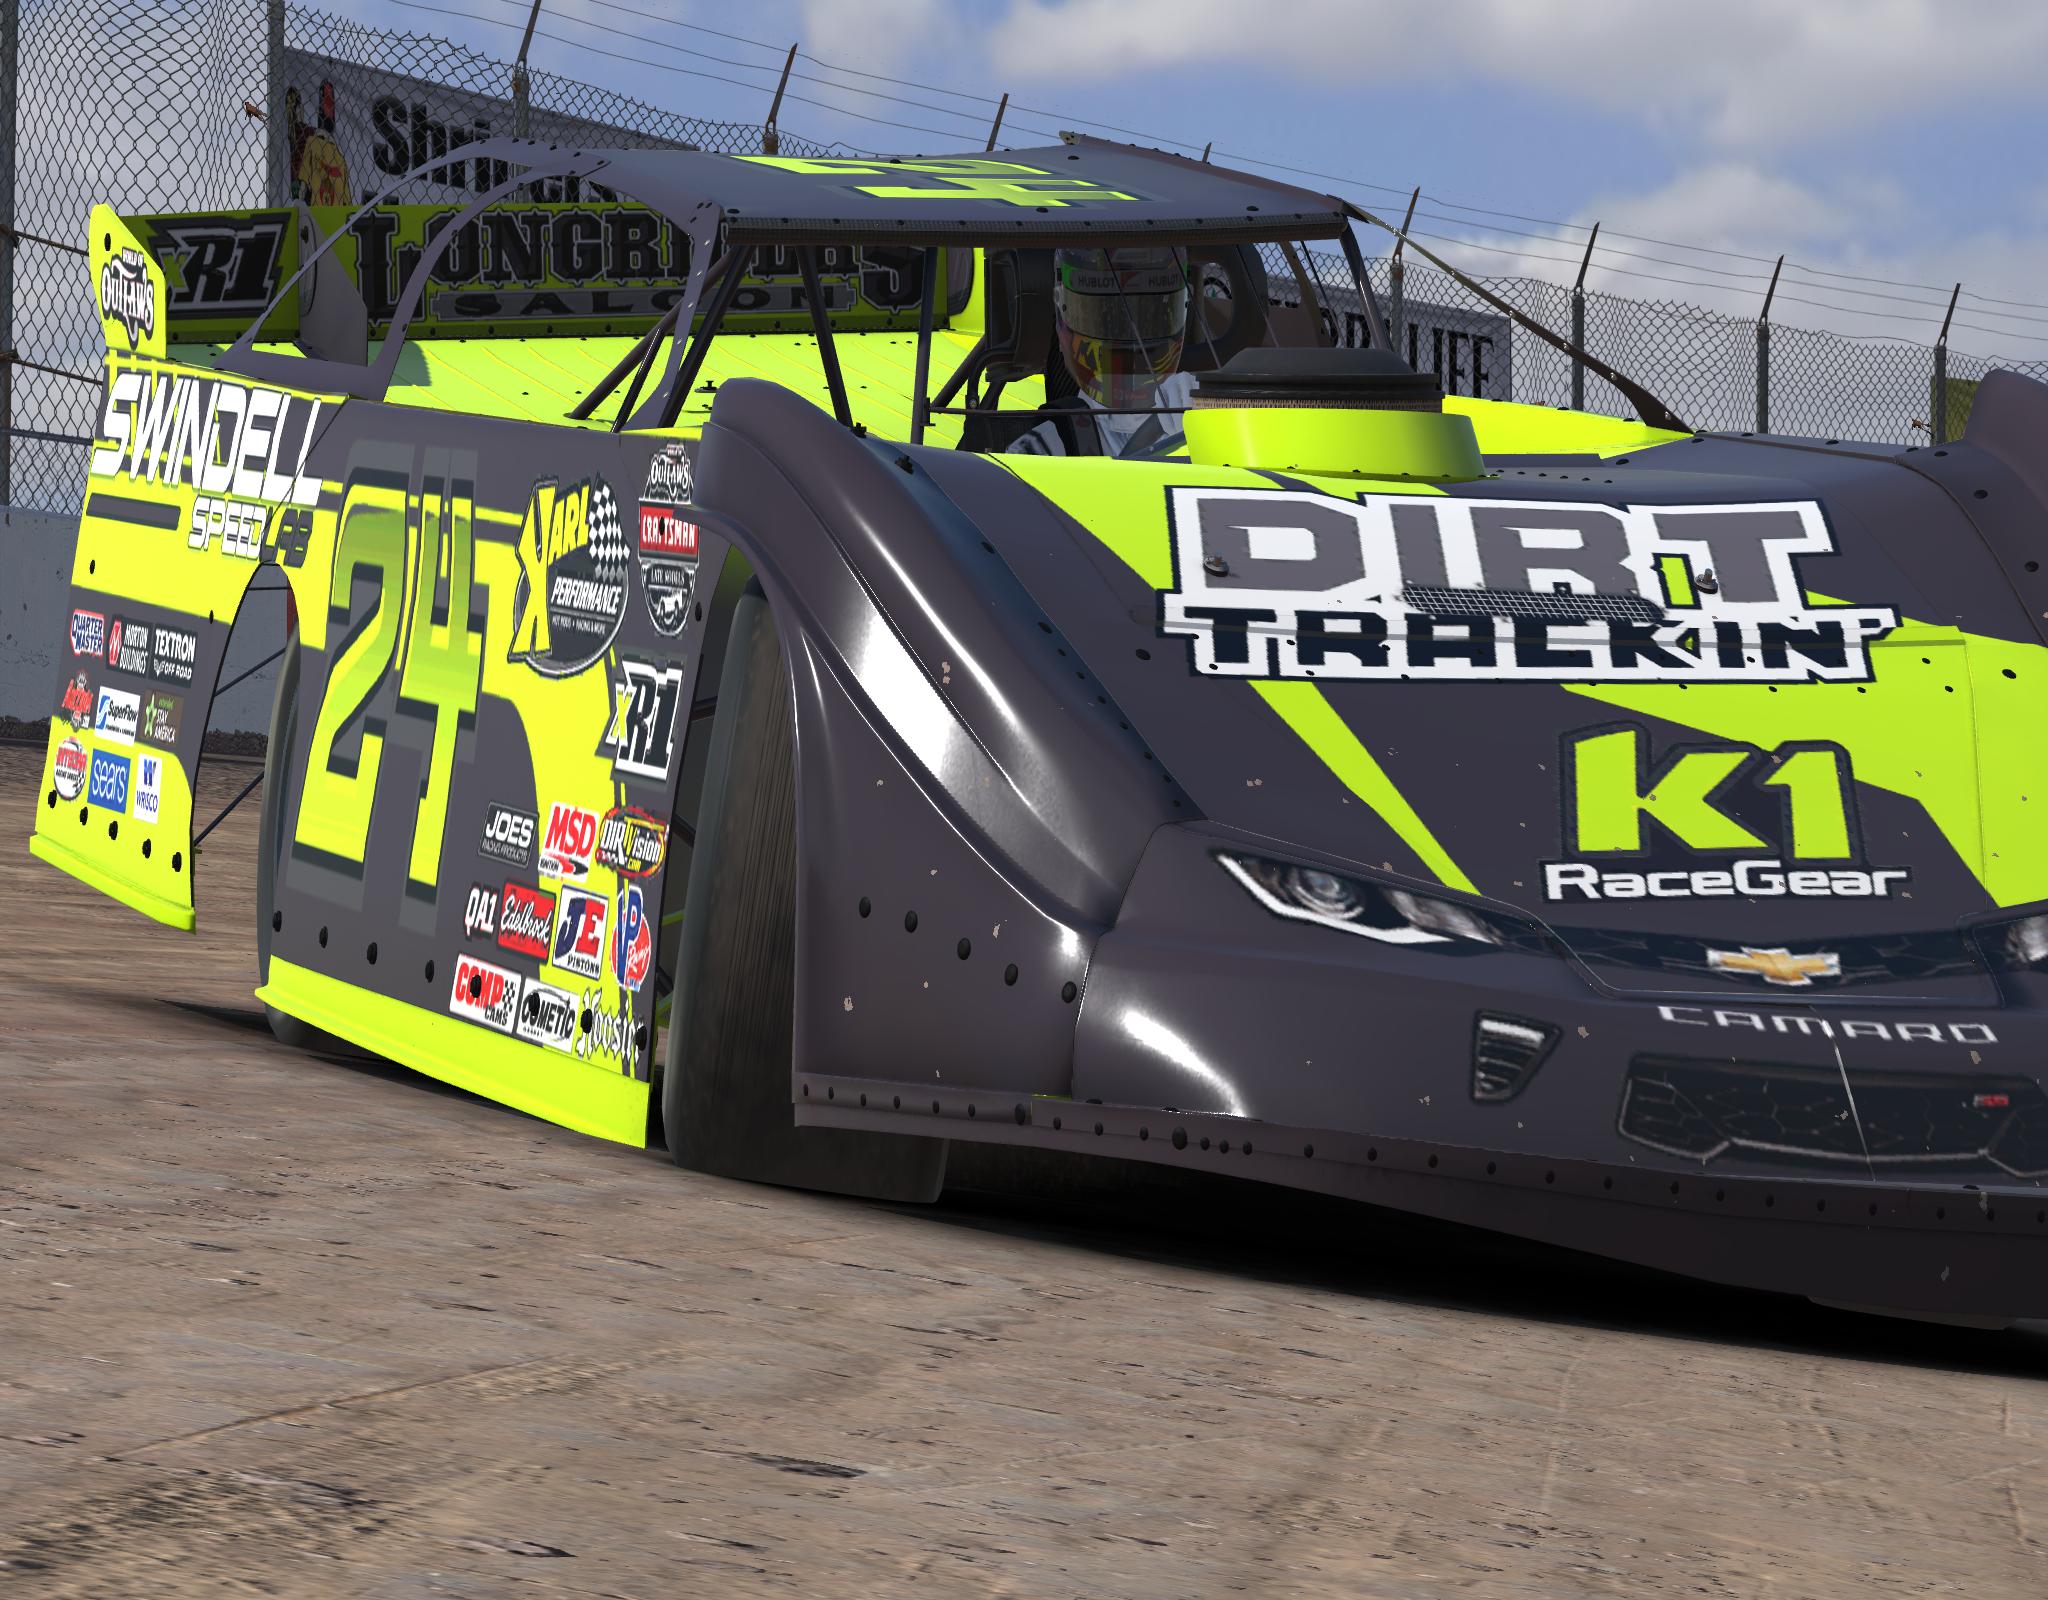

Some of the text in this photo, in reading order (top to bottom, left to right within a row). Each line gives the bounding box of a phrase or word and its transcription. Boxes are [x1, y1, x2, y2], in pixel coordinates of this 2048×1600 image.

[91, 372, 323, 507] SWINDELL
[642, 513, 696, 548] CRATSMAN
[1182, 495, 1820, 604] DIRT
[551, 575, 622, 615] PERFORMANCE
[124, 623, 149, 649] MORTON
[155, 628, 196, 663] TEXTRON
[164, 661, 192, 680] OFF ROAD
[295, 483, 482, 887] 24
[92, 759, 127, 804] sears
[136, 789, 159, 814] WRISCO
[1572, 729, 1853, 860] K1
[485, 809, 534, 849] JOES
[544, 805, 597, 858] MSD
[1544, 860, 1908, 901] RaceGear
[464, 887, 498, 936] QA1
[500, 893, 553, 945] Edelbrock
[484, 1004, 509, 1027] CAMS
[1657, 1005, 1999, 1044] CAMARO
